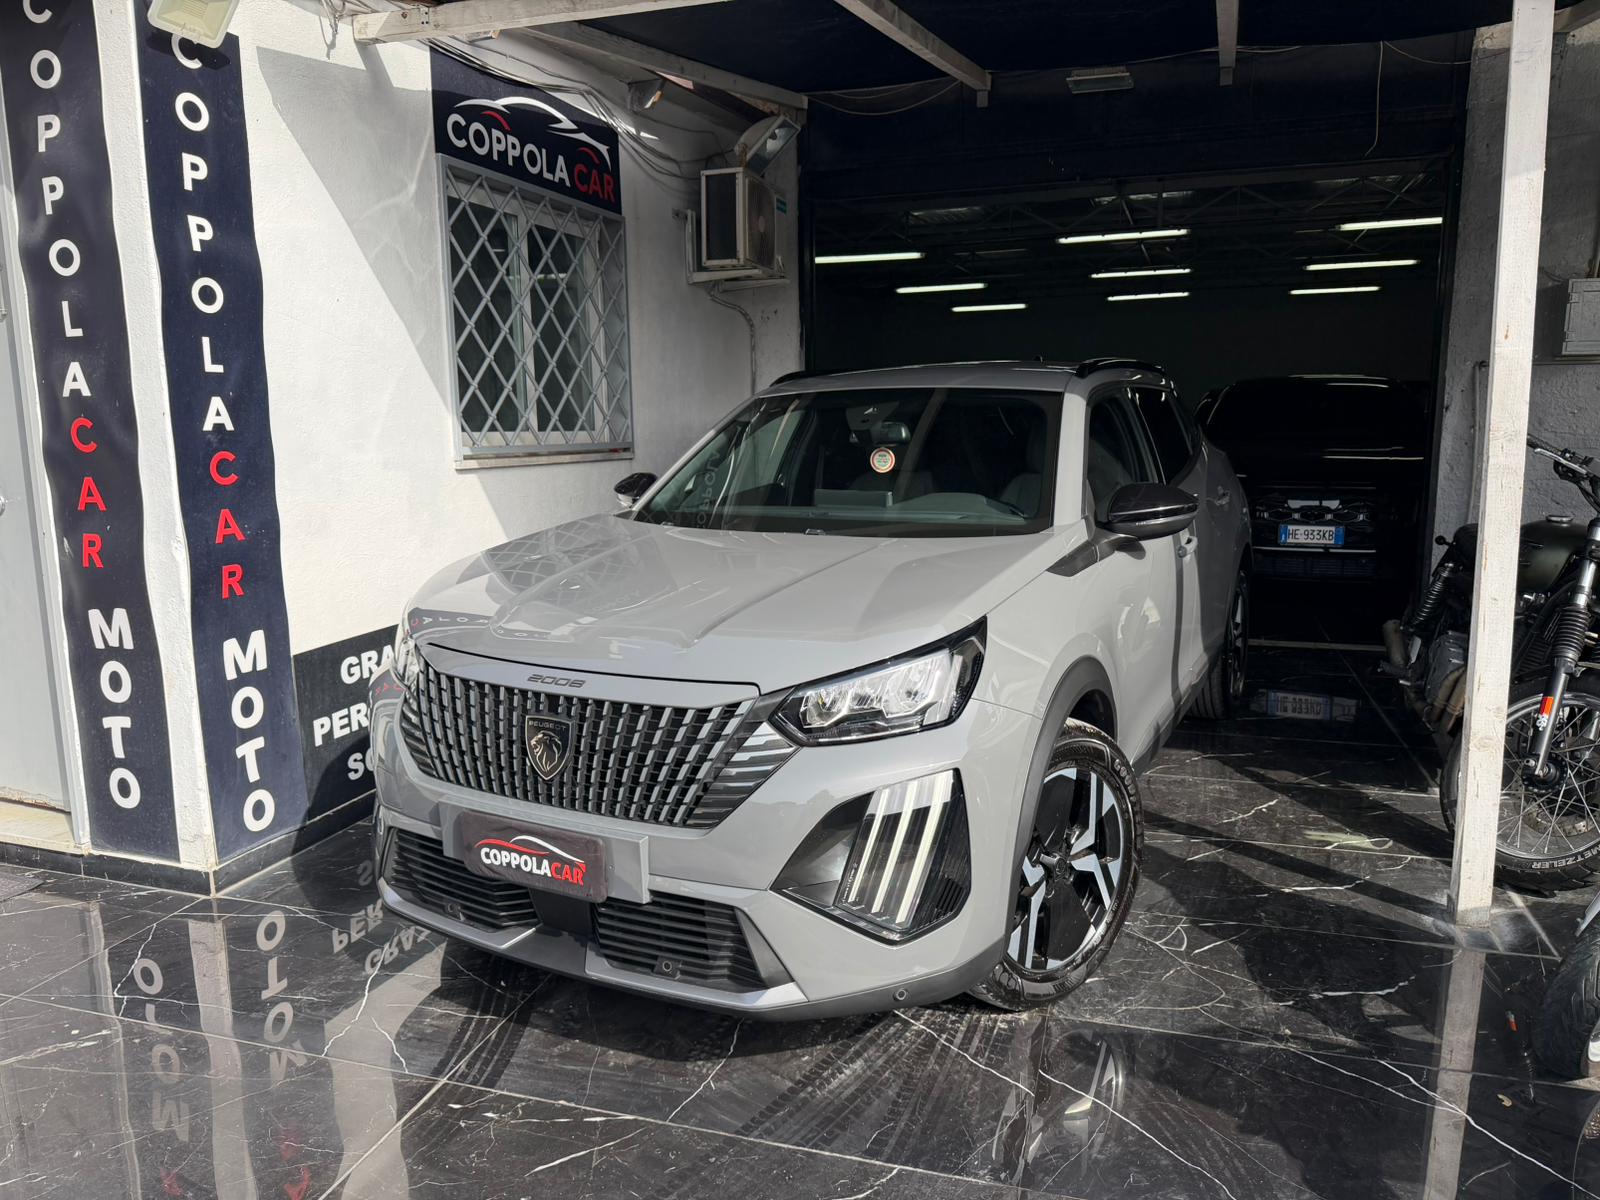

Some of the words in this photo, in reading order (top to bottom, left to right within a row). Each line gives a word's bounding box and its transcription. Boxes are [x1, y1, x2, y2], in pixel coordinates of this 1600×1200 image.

[340, 644, 396, 685] GRA
[527, 674, 586, 689] 2008
[88, 608, 141, 809] MOTO
[528, 720, 567, 730] PEUGEOT
[223, 629, 274, 832] MOTO
